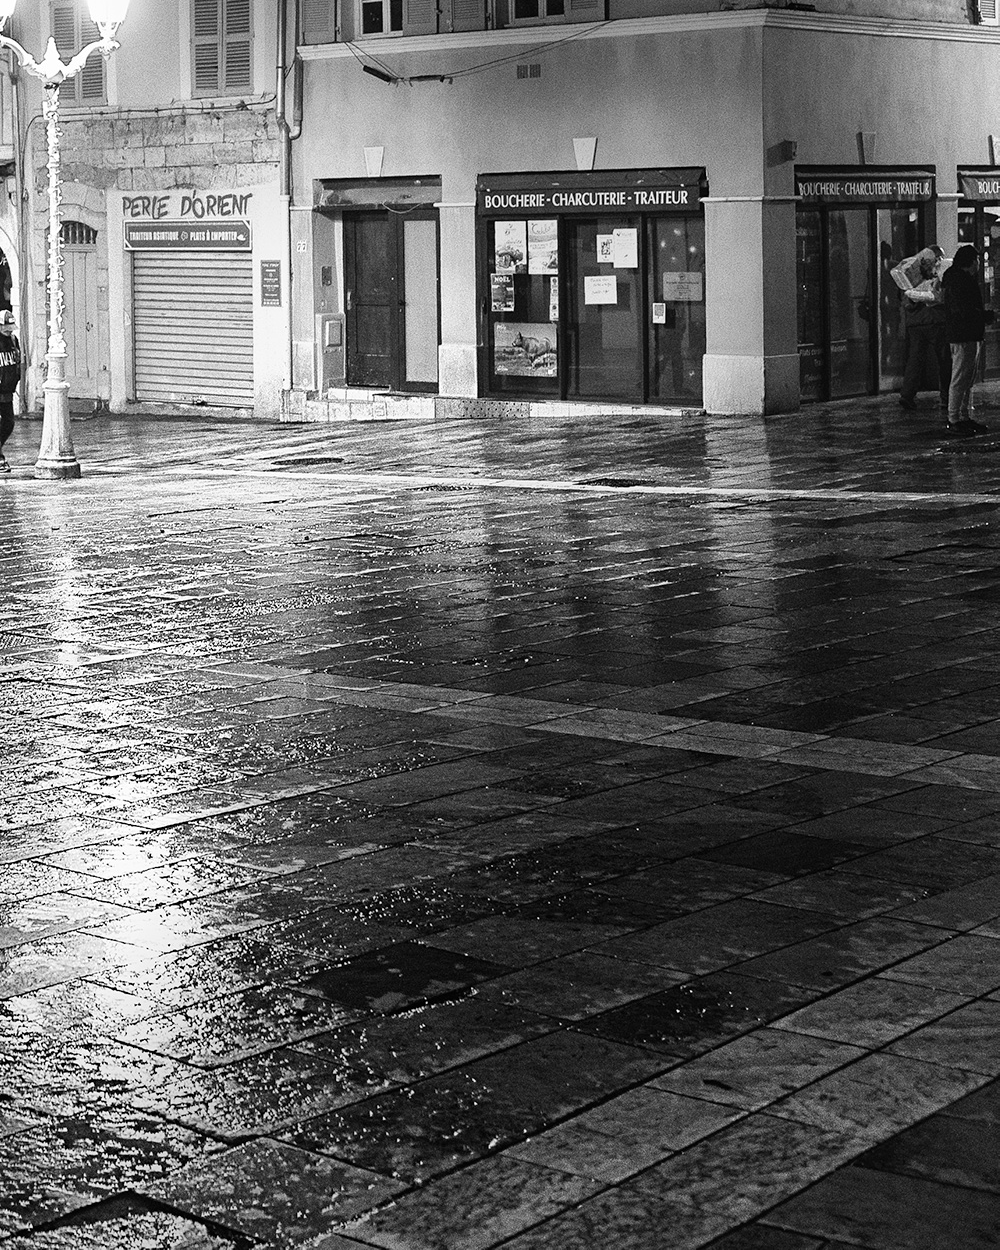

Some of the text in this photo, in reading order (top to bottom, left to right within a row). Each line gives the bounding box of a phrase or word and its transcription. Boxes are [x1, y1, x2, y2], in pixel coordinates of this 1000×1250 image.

[798, 181, 930, 196] BOUCHERIE CHARCUTERIE TRAITEUR
[181, 189, 252, 218] D'ORIENT
[485, 190, 689, 209] BOUCHERIE CHARCUTERIE TRAITEUR
